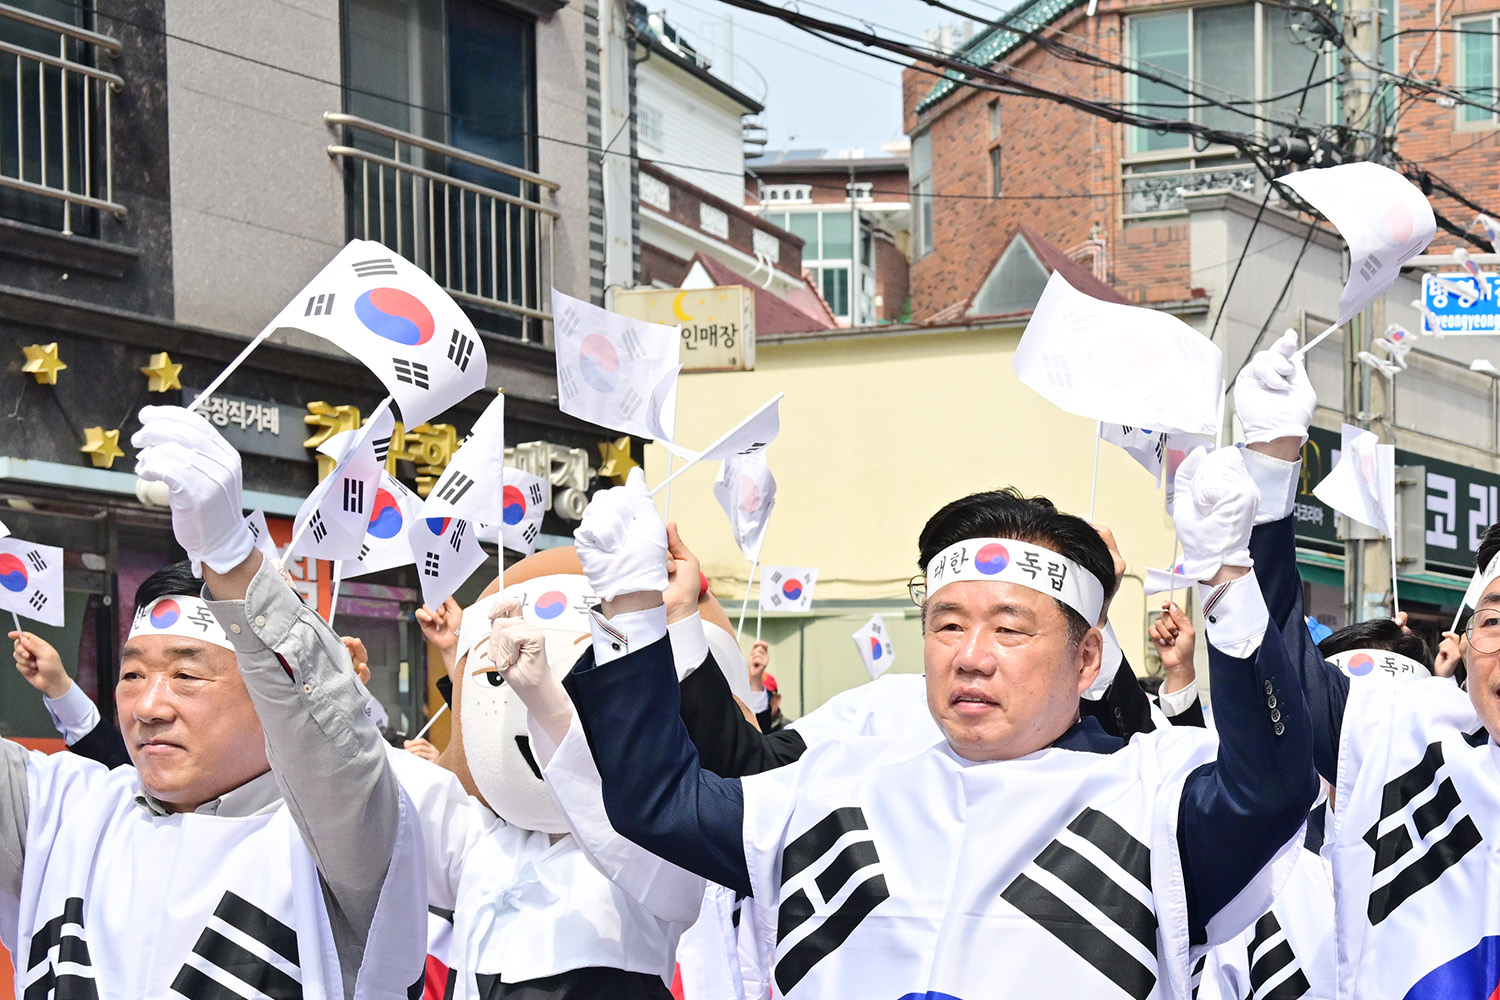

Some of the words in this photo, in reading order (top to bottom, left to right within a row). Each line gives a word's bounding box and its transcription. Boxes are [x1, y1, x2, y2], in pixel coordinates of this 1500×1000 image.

[1431, 312, 1500, 330] yeongyeong
[677, 323, 738, 351] 인매장
[934, 547, 969, 582] 대한
[1015, 550, 1068, 592] 독립
[187, 606, 216, 634] 독
